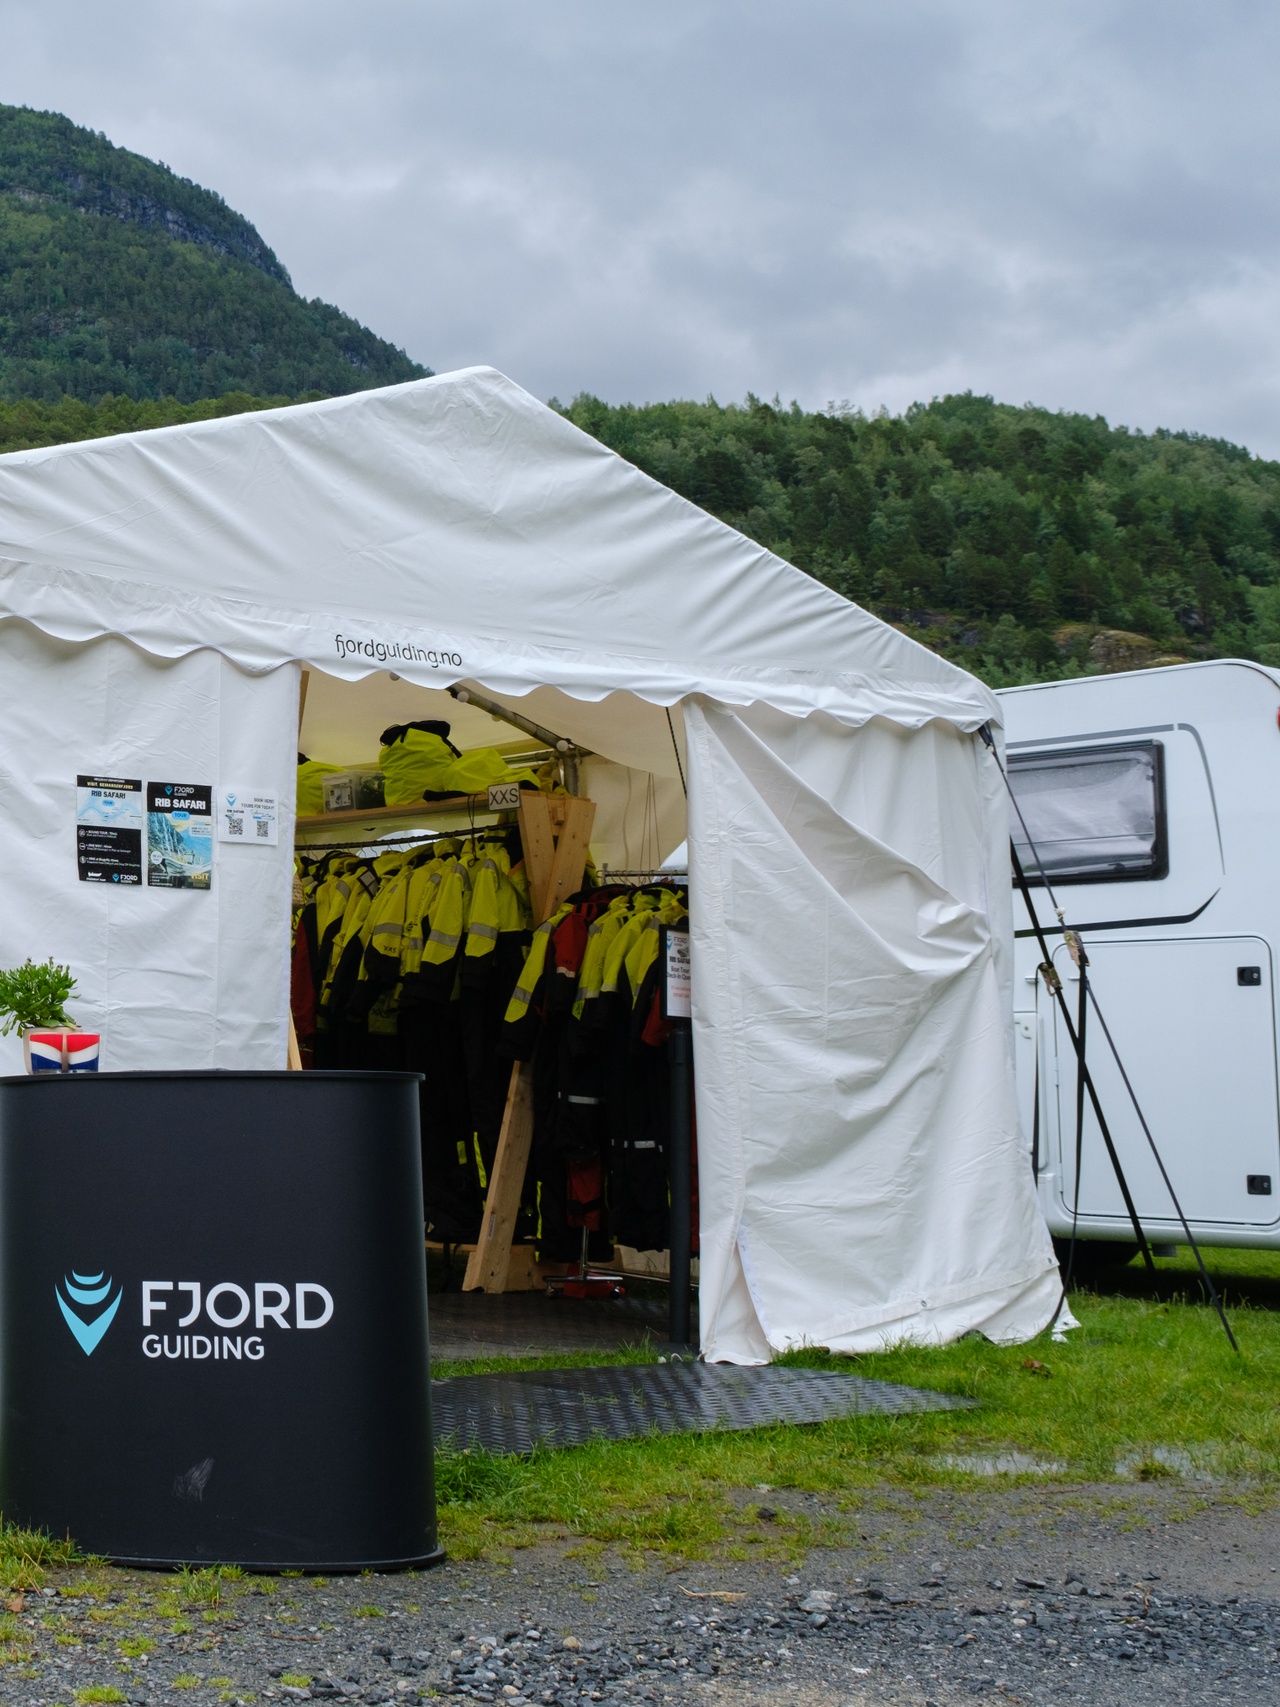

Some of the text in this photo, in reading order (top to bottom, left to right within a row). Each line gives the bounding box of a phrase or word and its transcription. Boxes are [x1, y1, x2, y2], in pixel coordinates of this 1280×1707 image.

[334, 634, 463, 669] fjordguiding.no
[155, 798, 206, 809] RIB SAFARI
[489, 787, 520, 806] XXS
[190, 872, 209, 880] VISIT
[141, 1280, 335, 1330] FJORD
[141, 1333, 265, 1361] GUIDING
